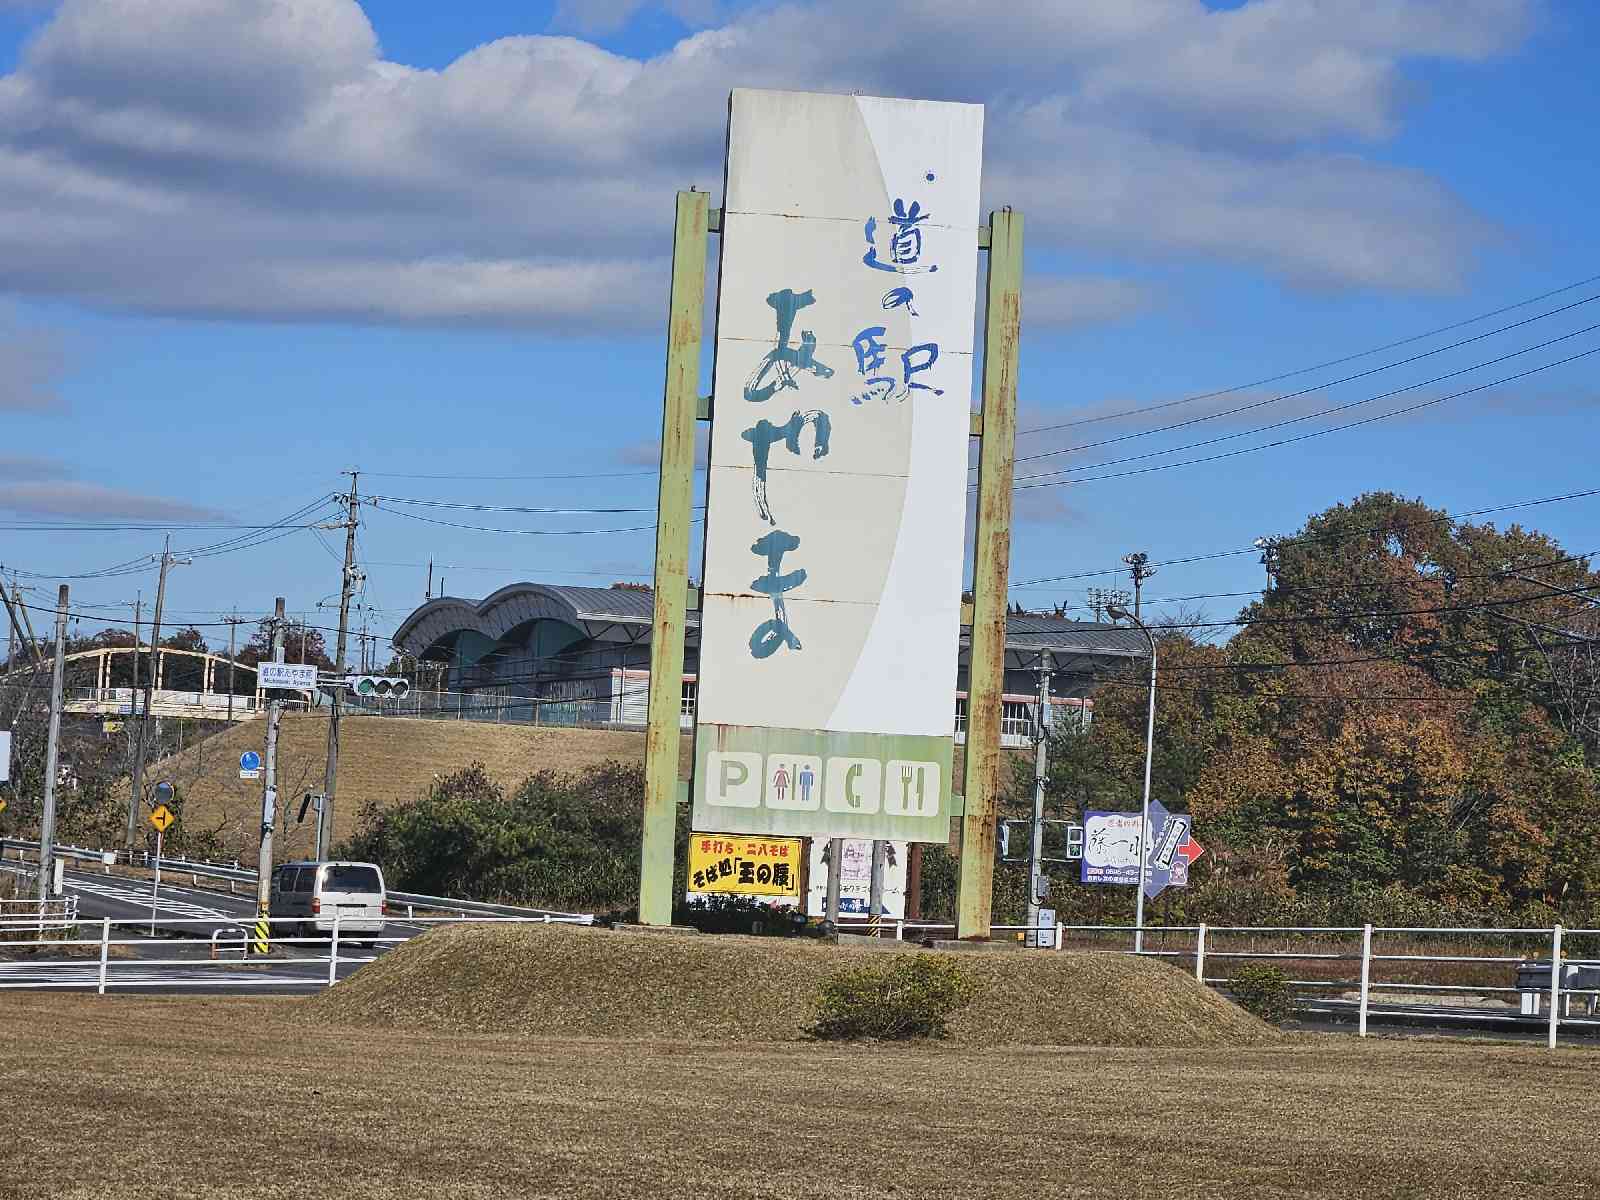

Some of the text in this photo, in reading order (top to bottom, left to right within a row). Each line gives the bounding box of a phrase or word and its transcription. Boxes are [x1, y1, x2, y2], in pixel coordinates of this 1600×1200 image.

[851, 198, 944, 404] 道の駅
[741, 288, 834, 659] あやま
[720, 760, 748, 797] P
